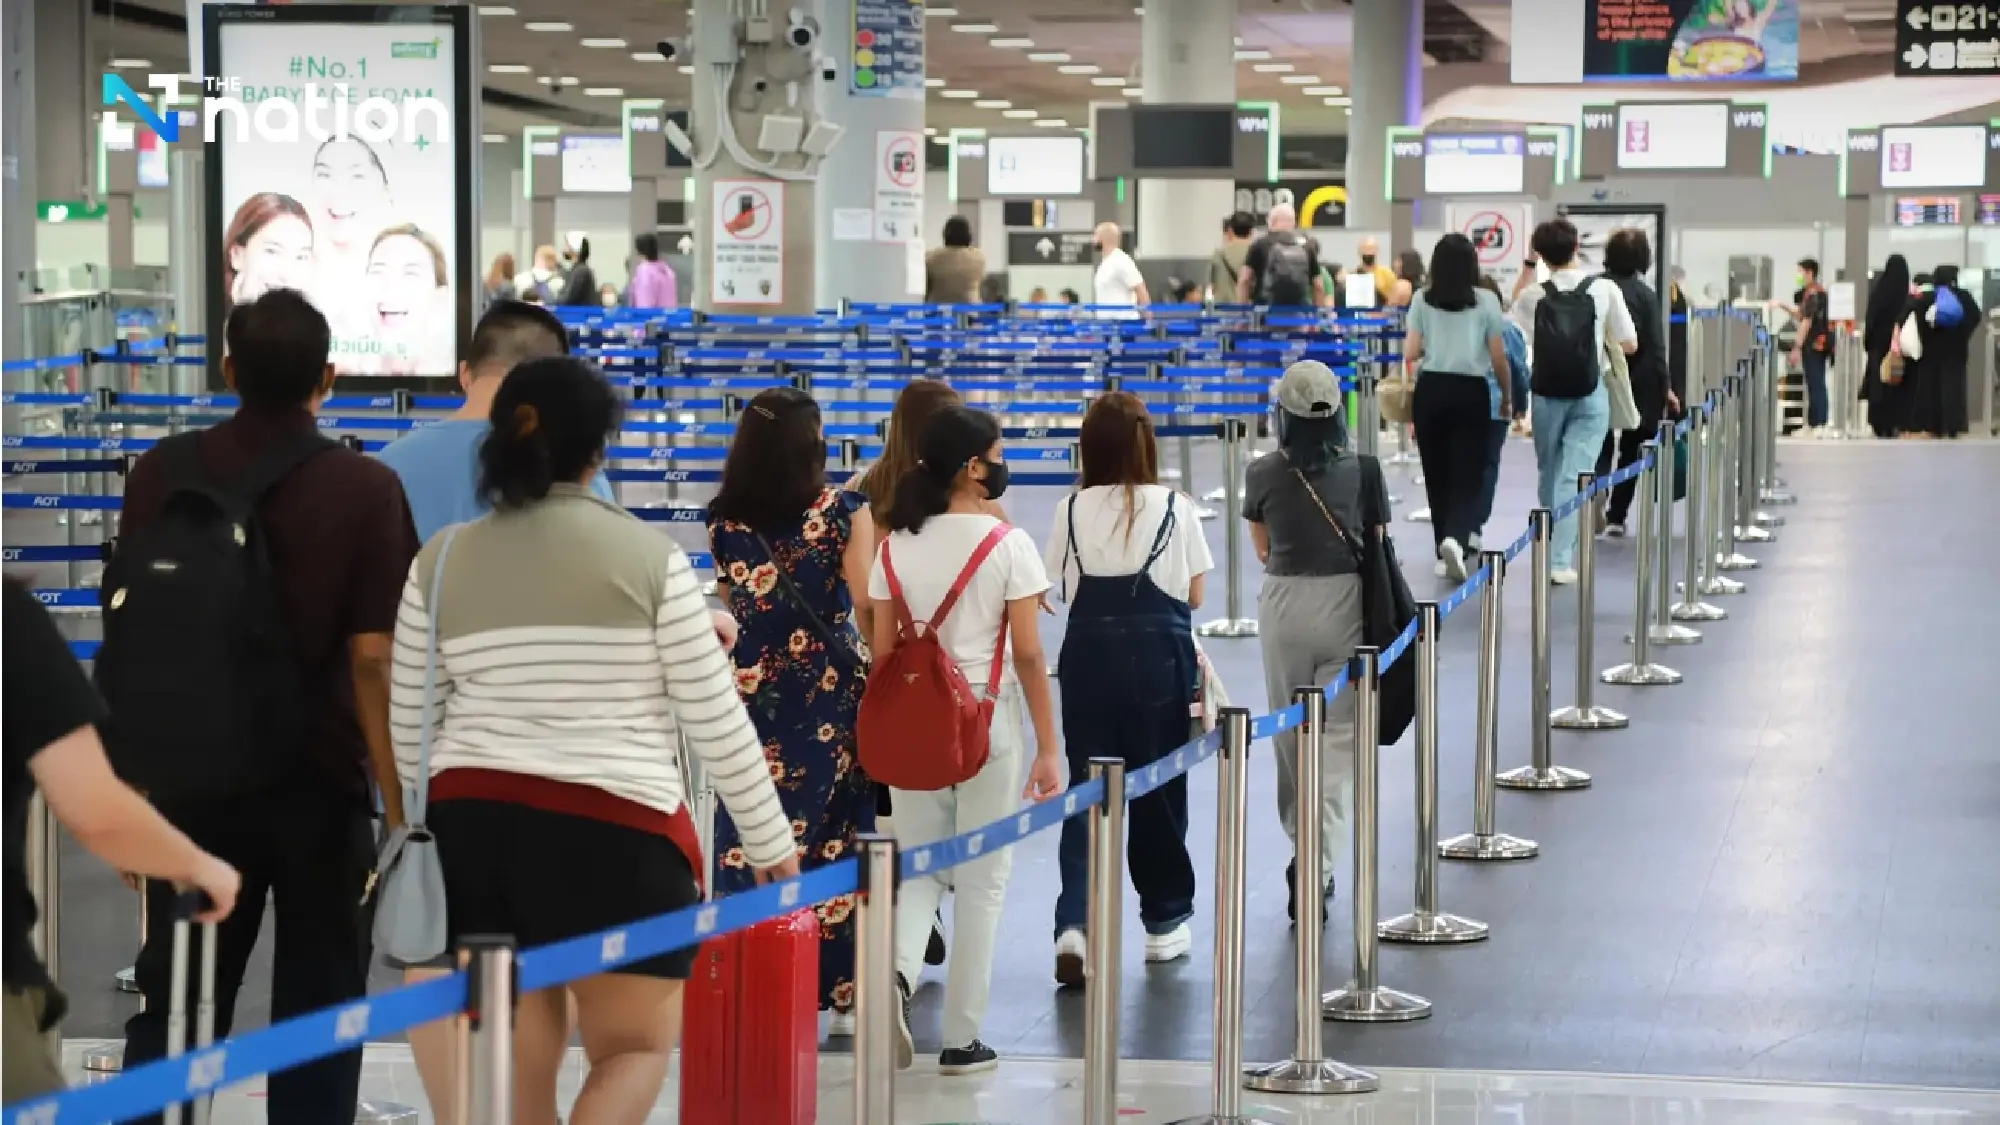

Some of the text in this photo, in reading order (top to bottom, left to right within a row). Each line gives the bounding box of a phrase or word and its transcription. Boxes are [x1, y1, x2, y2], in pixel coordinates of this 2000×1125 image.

[1957, 5, 2000, 29] 21-
[289, 57, 367, 79] #No.1
[651, 448, 674, 458] AOT
[1041, 450, 1064, 460] AOT
[12, 462, 38, 473] AOT
[664, 471, 690, 482] AOT
[33, 496, 61, 507] AOT
[672, 510, 701, 521] AOT
[2, 549, 23, 560] OT
